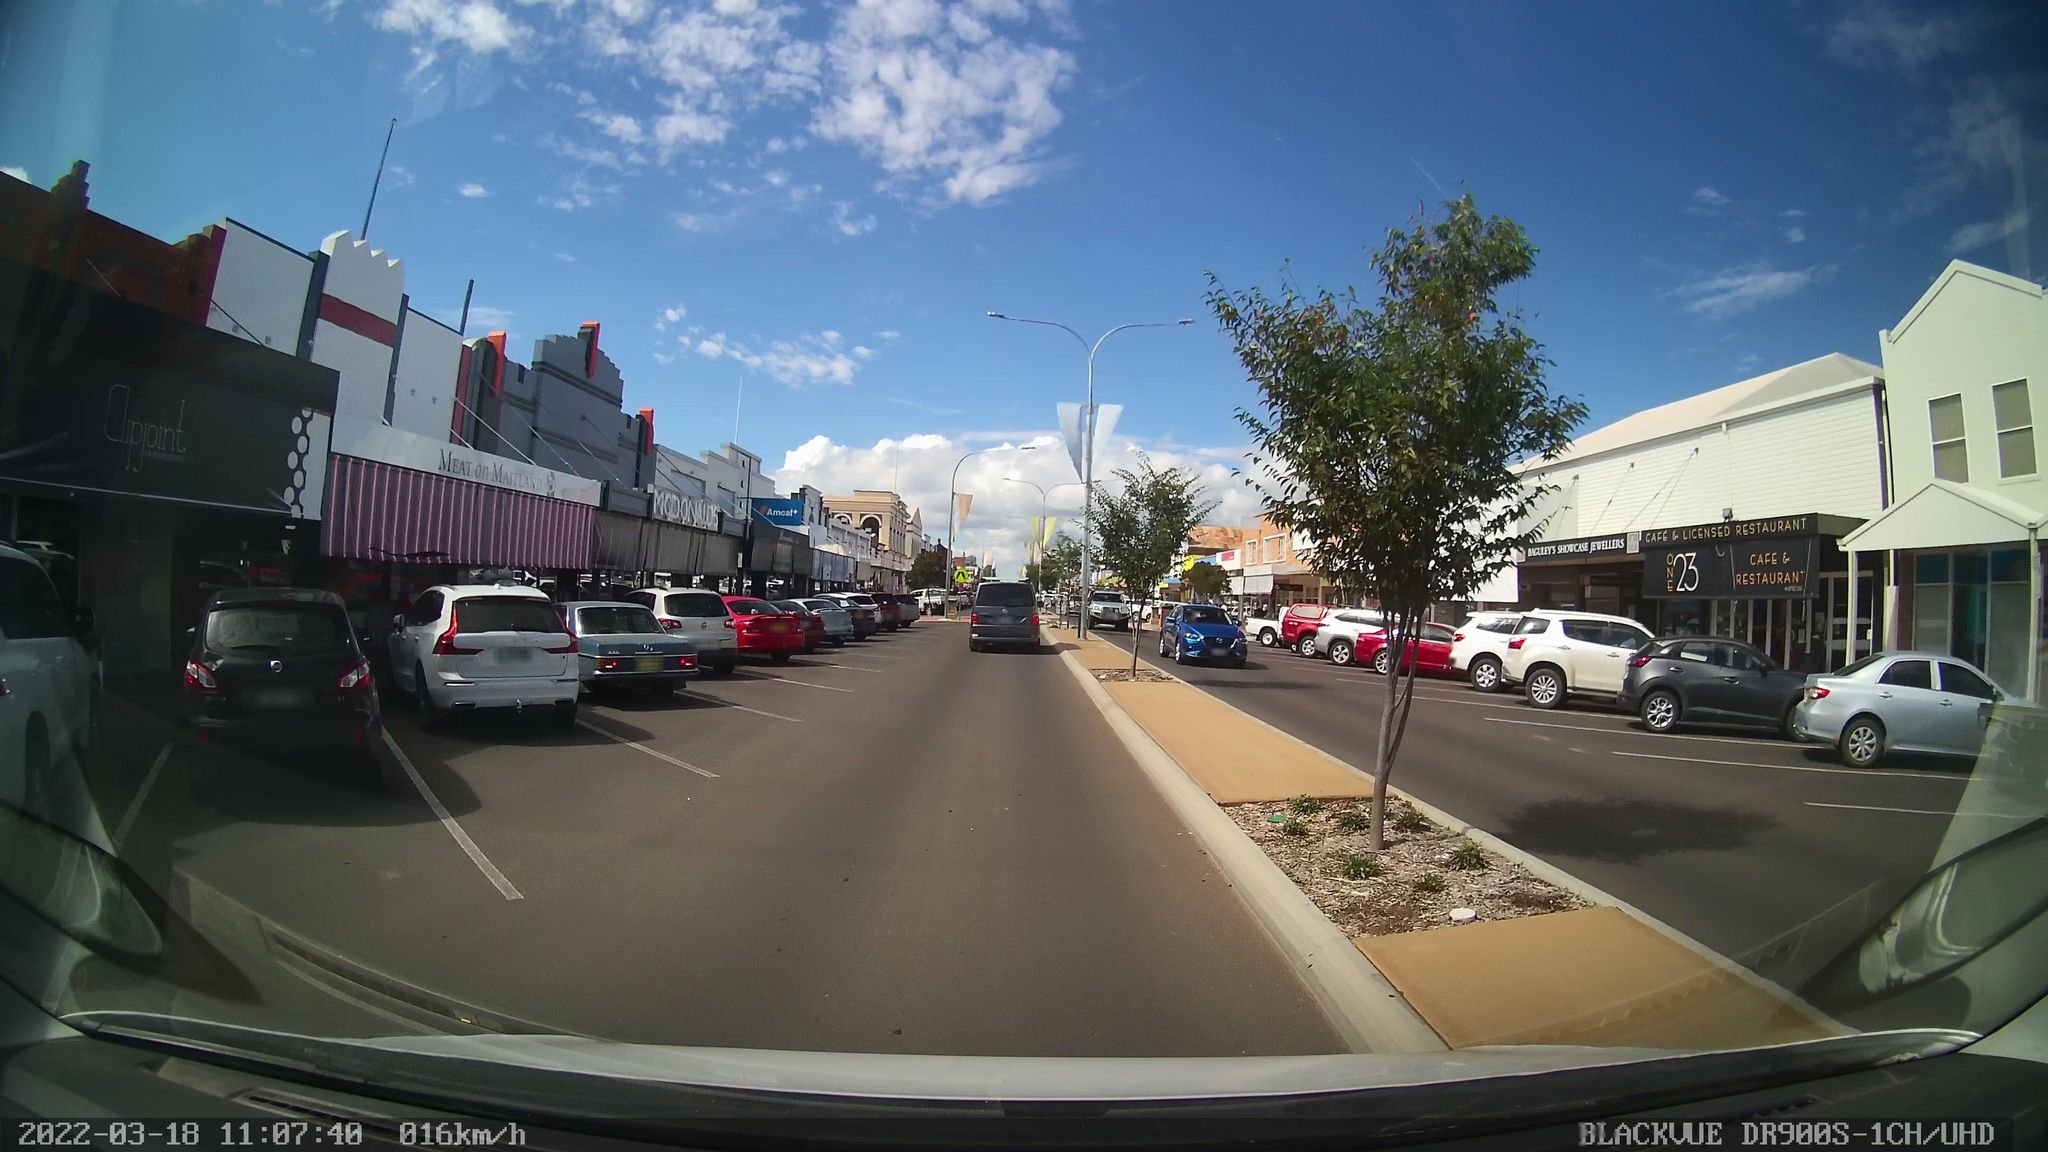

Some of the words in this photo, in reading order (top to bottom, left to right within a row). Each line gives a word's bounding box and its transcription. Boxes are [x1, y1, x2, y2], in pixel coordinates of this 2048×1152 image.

[439, 448, 472, 477] MEAT
[475, 464, 489, 481] on
[1672, 530, 1679, 541] &
[1682, 526, 1731, 540] LICENSED
[1735, 517, 1807, 536] RESTAURANT
[1557, 542, 1589, 554] SHOWCASE
[1589, 538, 1625, 553] JEWELLERS
[1750, 552, 1777, 566] CAFE
[1782, 551, 1790, 564] &
[1666, 553, 1674, 592] ONE
[1673, 552, 1699, 592] 23
